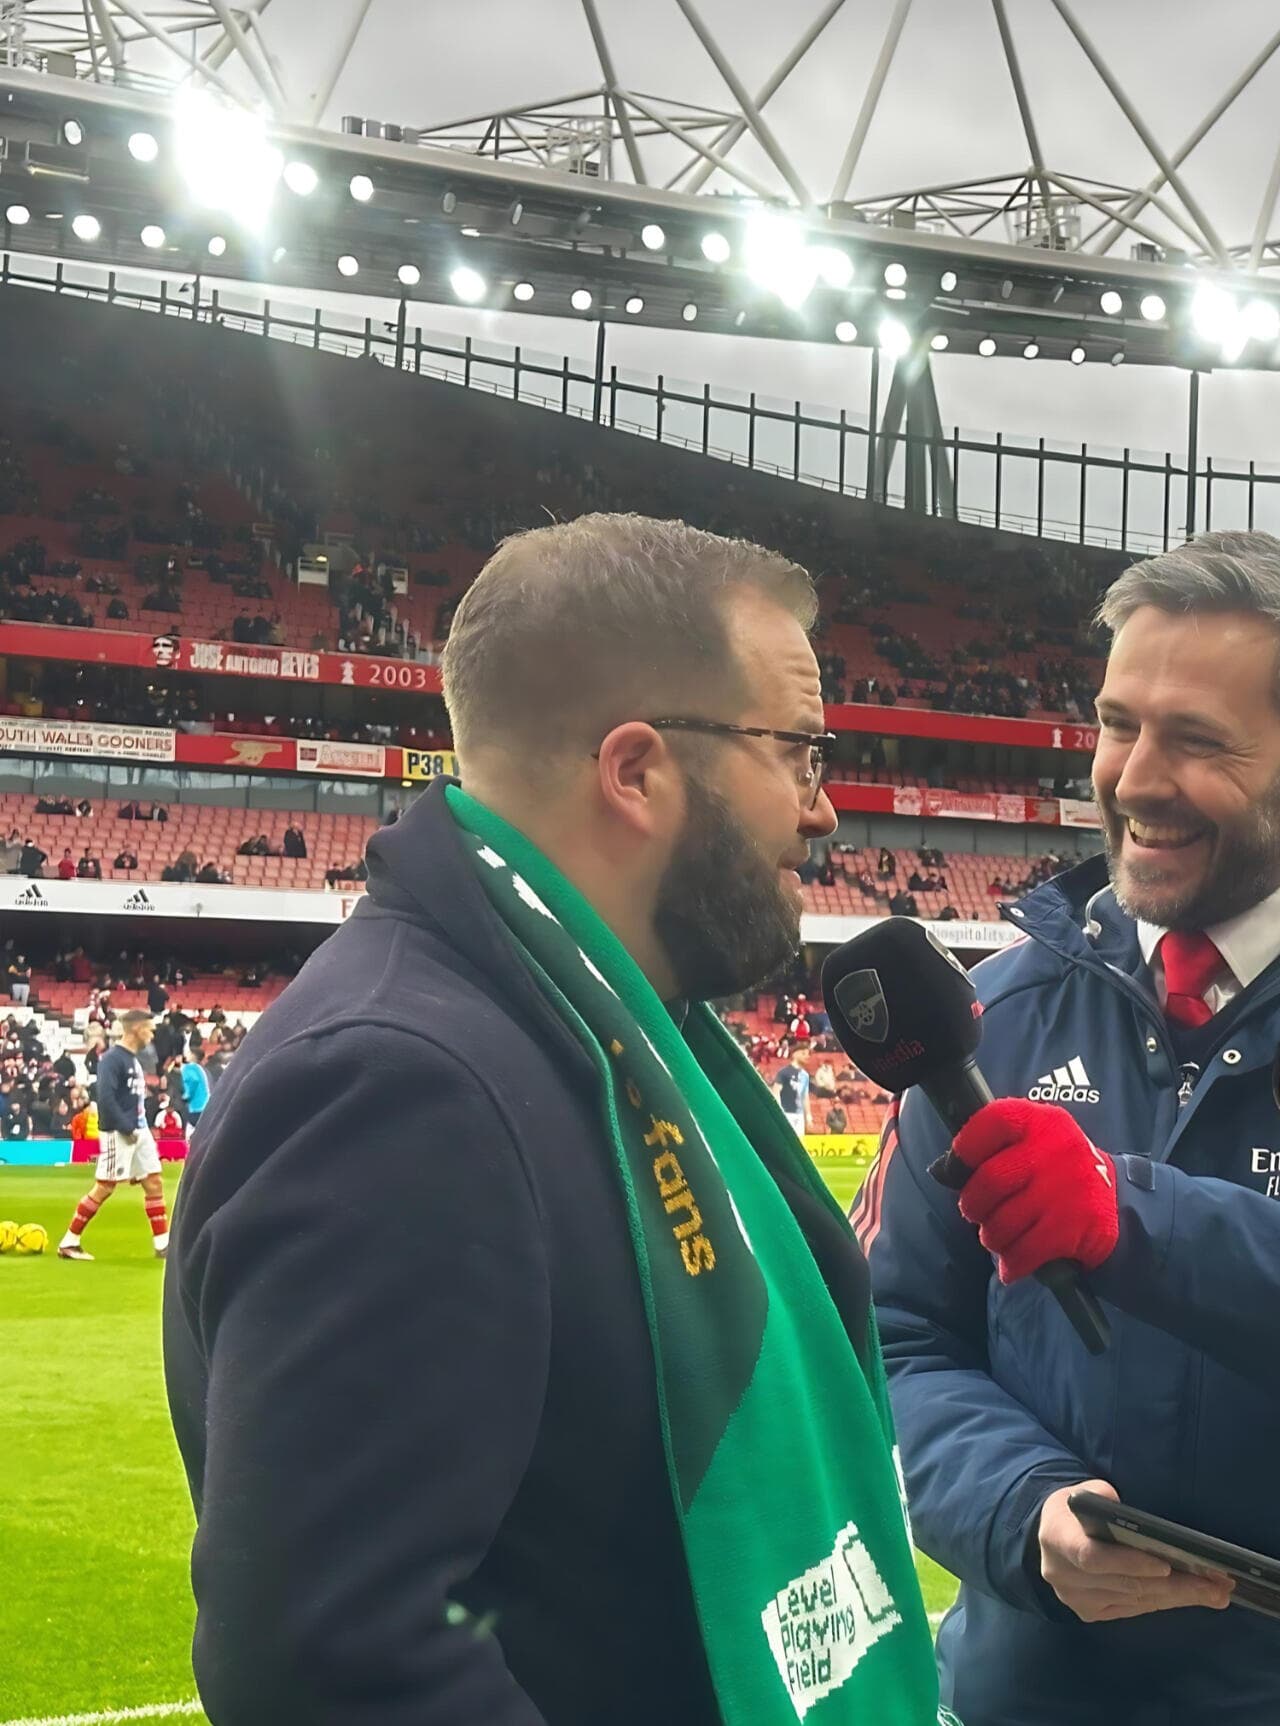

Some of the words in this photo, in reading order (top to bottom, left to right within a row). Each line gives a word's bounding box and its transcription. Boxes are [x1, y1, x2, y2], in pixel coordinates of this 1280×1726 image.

[369, 663, 427, 688] 2003
[41, 730, 94, 748] WALES
[98, 735, 174, 752] GOONERS
[406, 752, 444, 776] P38
[1027, 1083, 1101, 1104] adidas
[643, 1114, 717, 1277] fans
[776, 1563, 838, 1624] Level
[787, 1647, 833, 1696] Field
